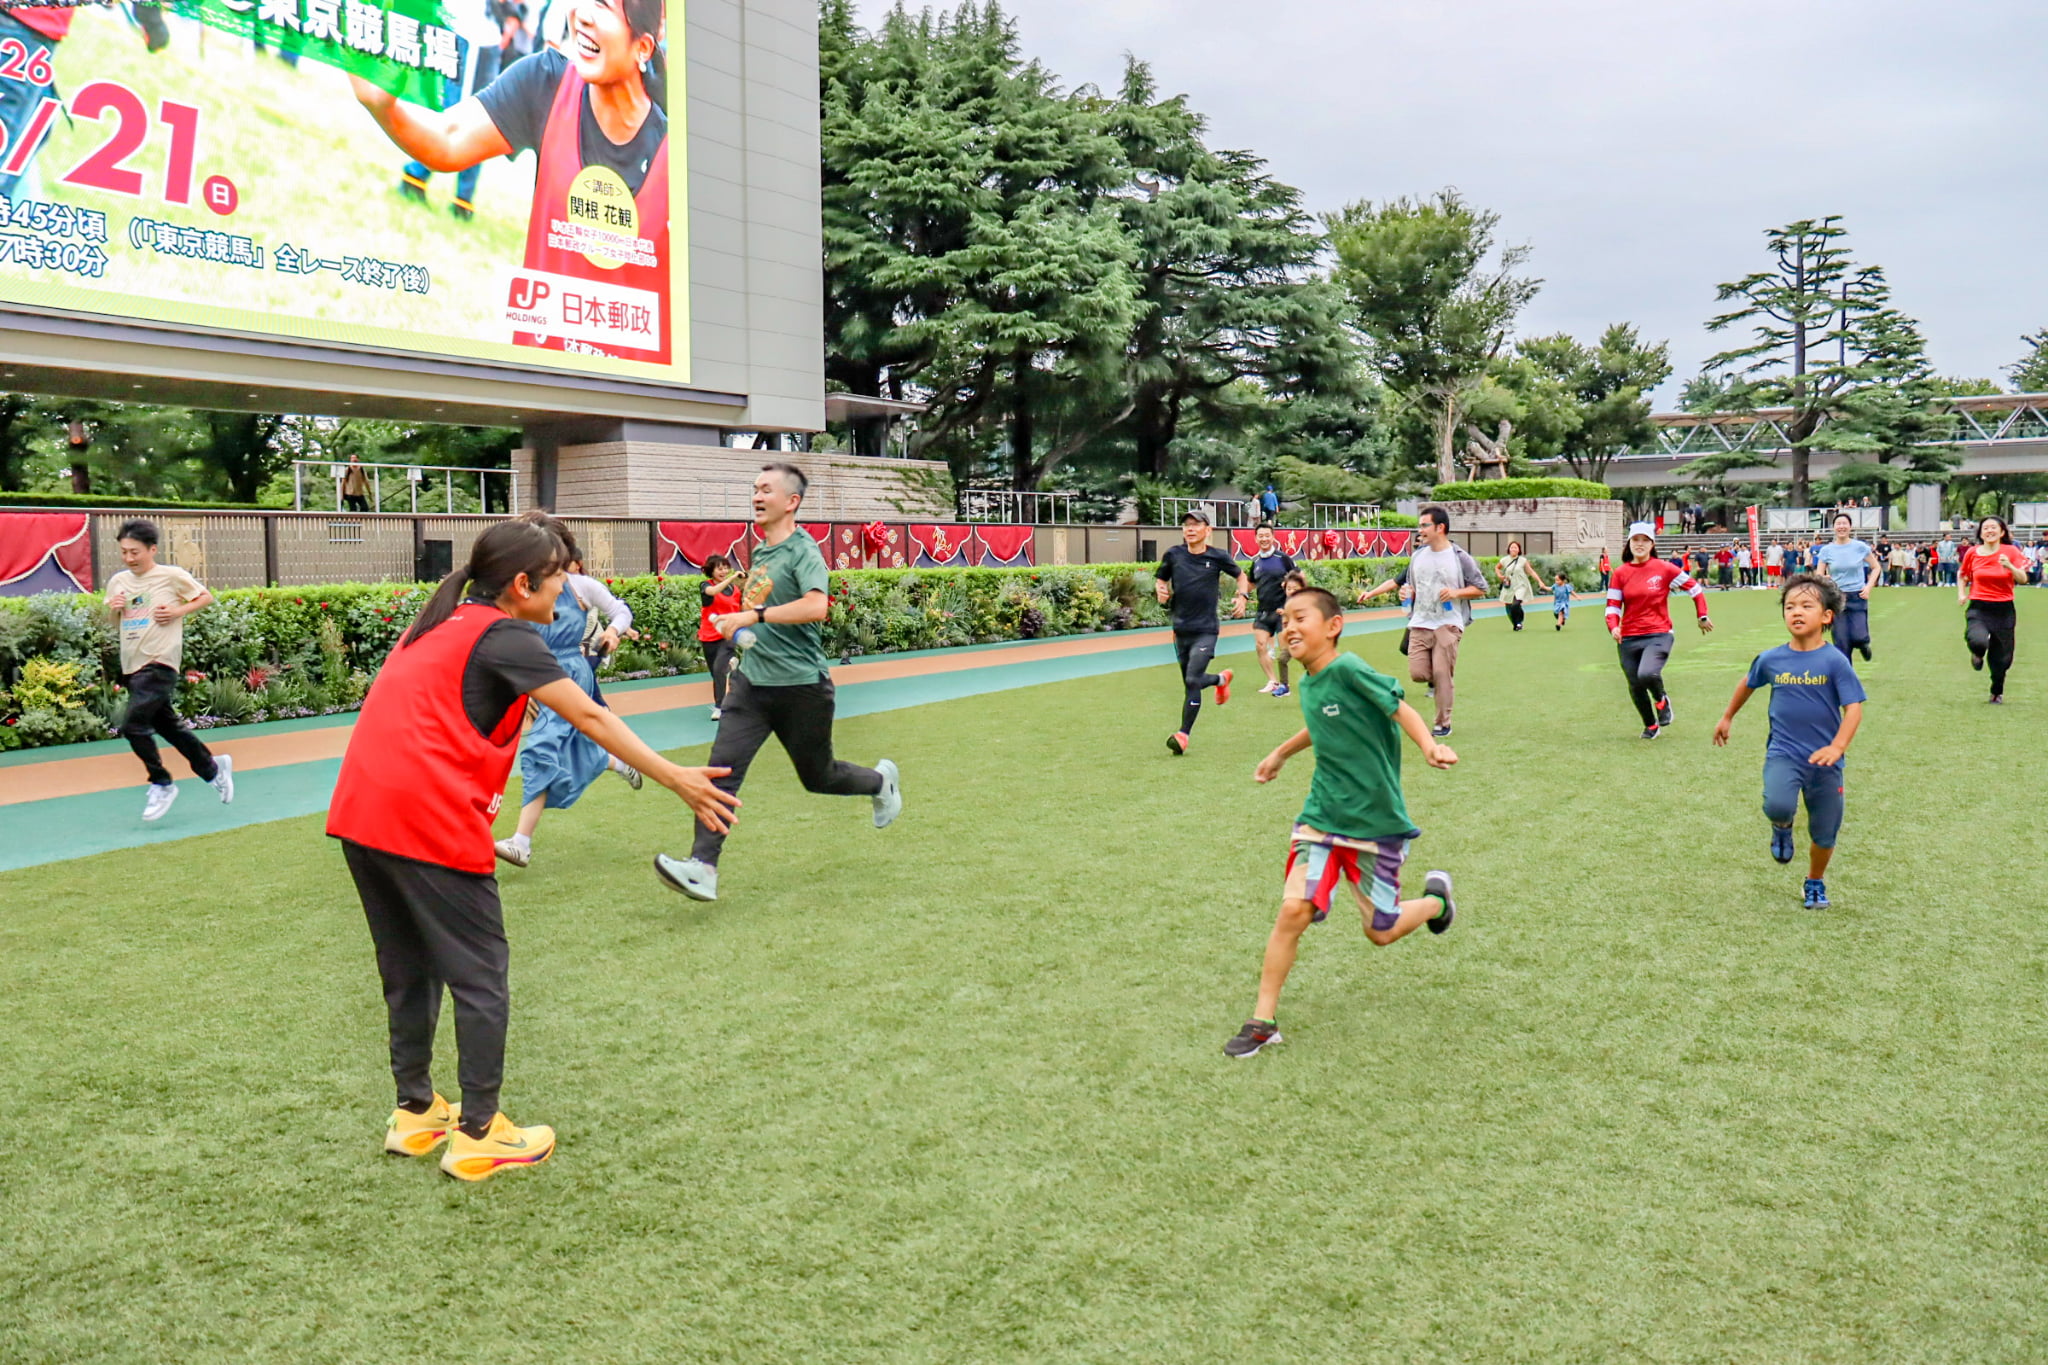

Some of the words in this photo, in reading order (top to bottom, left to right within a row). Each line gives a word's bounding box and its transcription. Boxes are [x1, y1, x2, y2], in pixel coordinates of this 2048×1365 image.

[220, 0, 459, 79] 東京競馬場
[0, 39, 53, 86] 26
[0, 82, 199, 206] /21
[211, 183, 231, 206] 日
[570, 195, 600, 221] 関根
[507, 276, 551, 311] JP
[562, 292, 652, 336] 日本郵政
[506, 311, 548, 326] HOLDINGS
